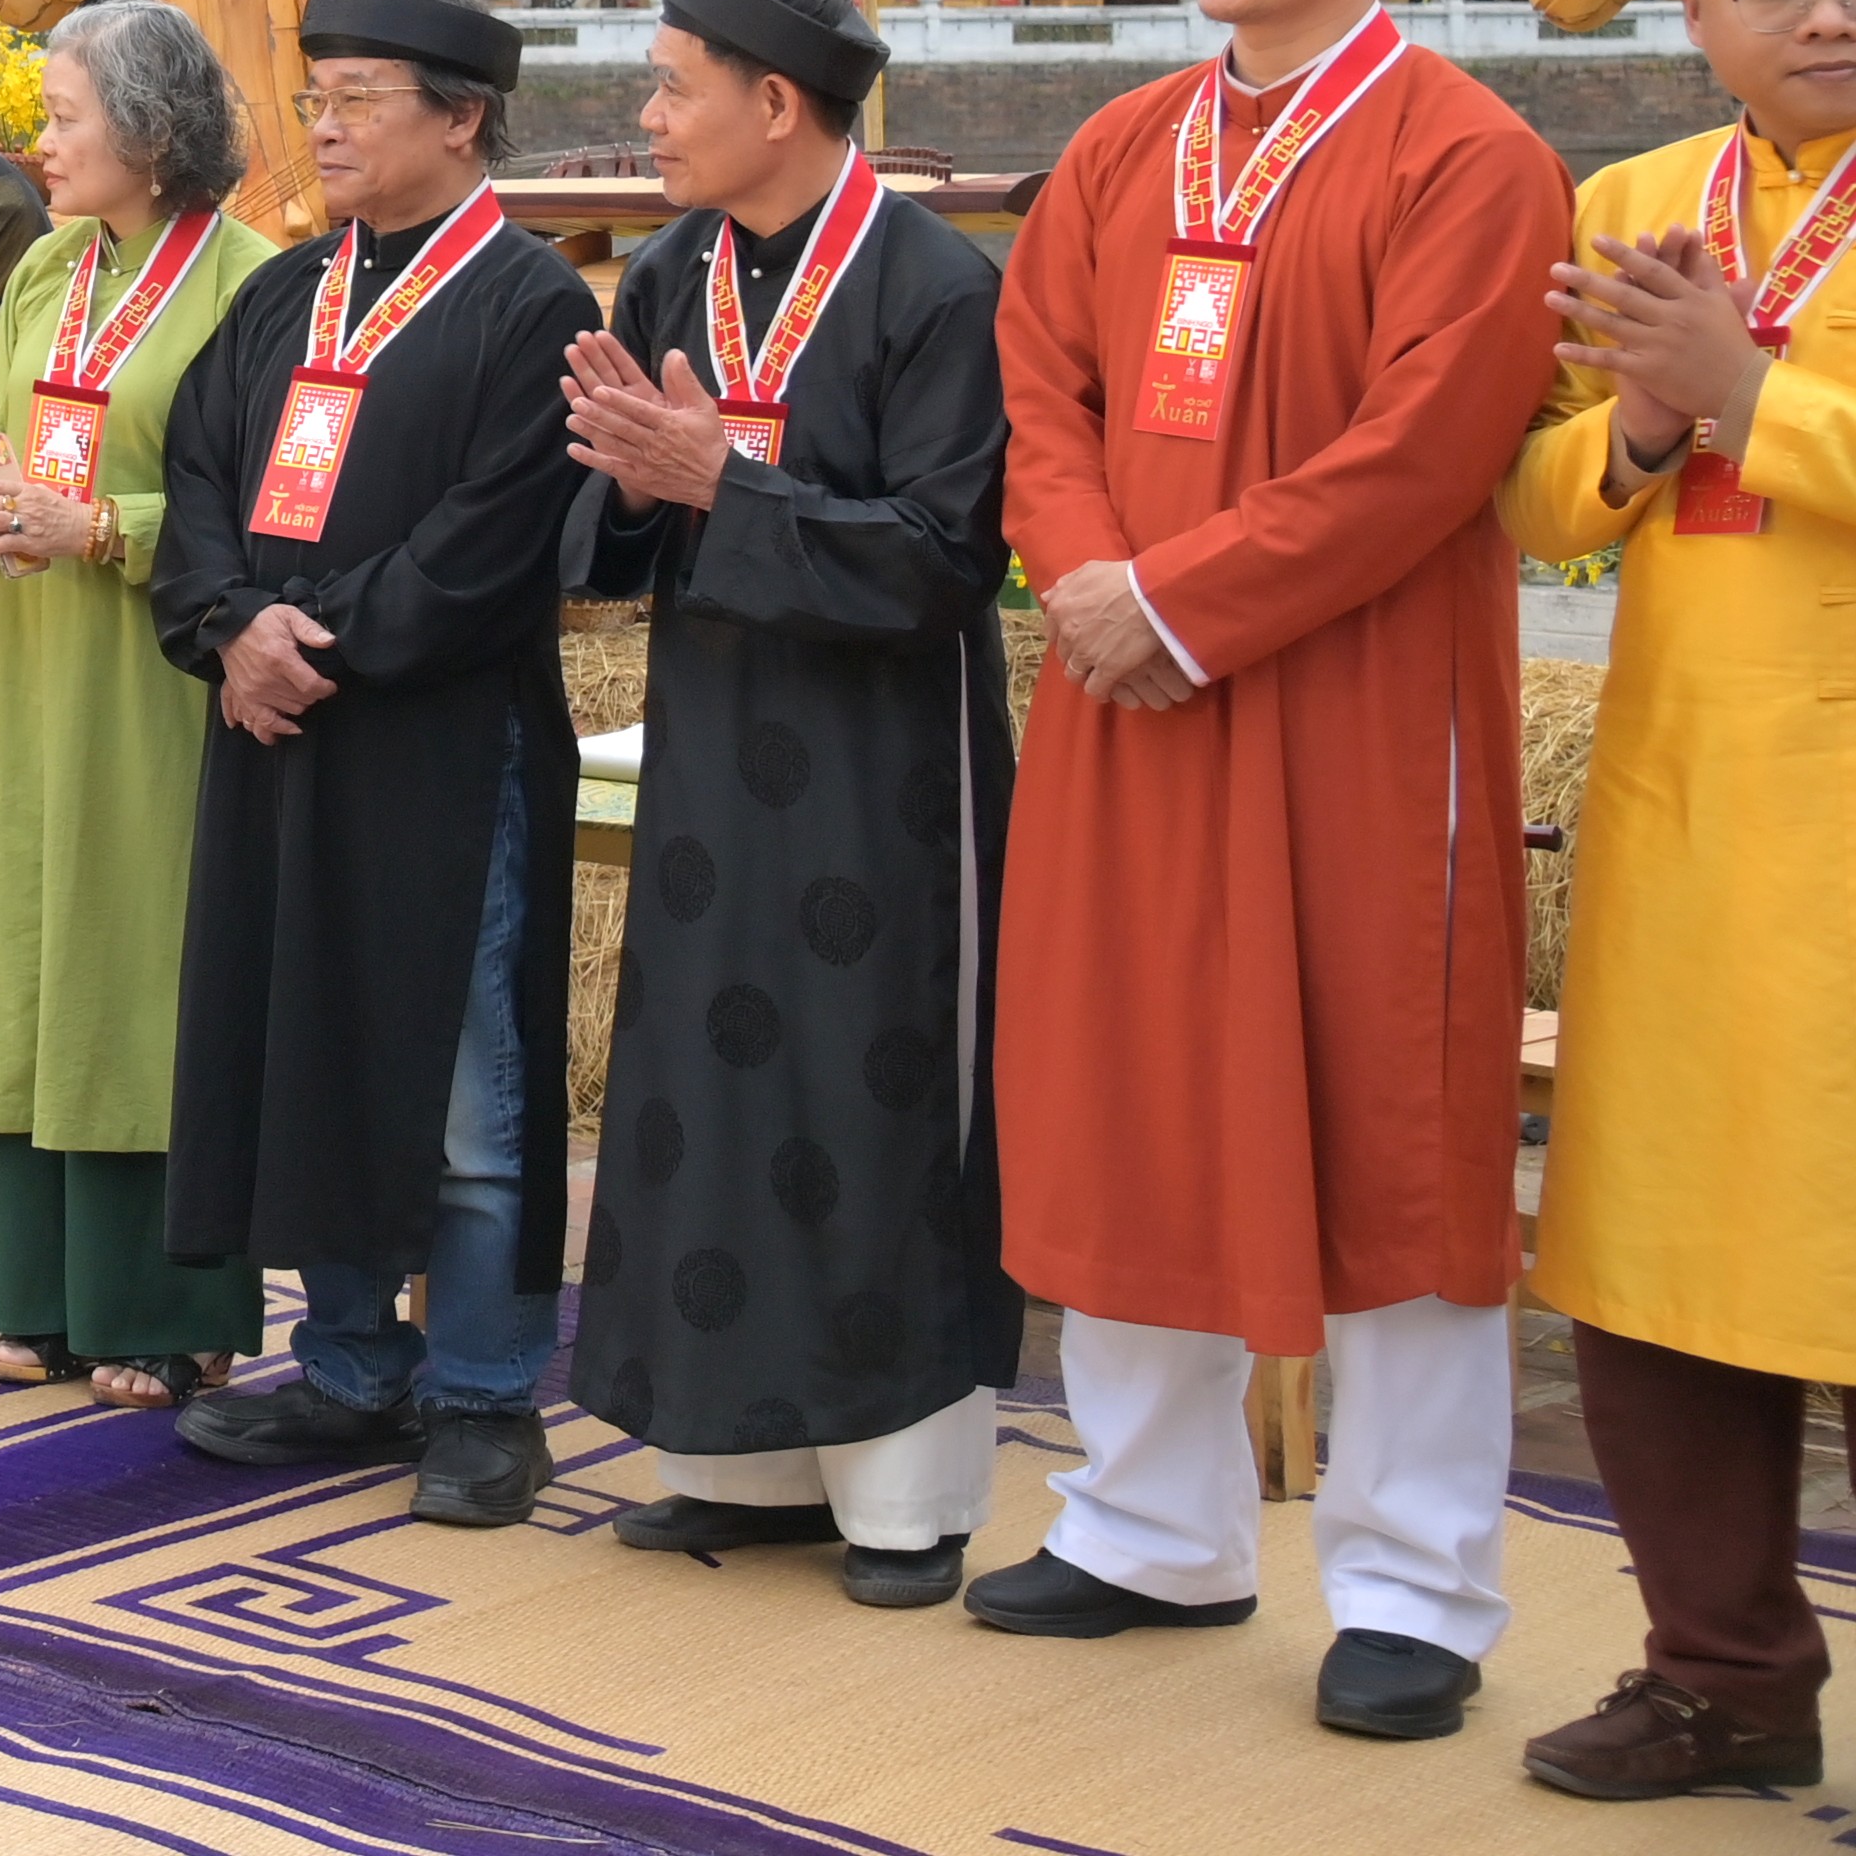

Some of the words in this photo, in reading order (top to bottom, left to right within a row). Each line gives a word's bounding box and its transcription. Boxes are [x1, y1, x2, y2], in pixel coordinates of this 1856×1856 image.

[1159, 325, 1226, 355] 2026
[278, 442, 335, 467] 2026
[31, 455, 88, 484] 2026
